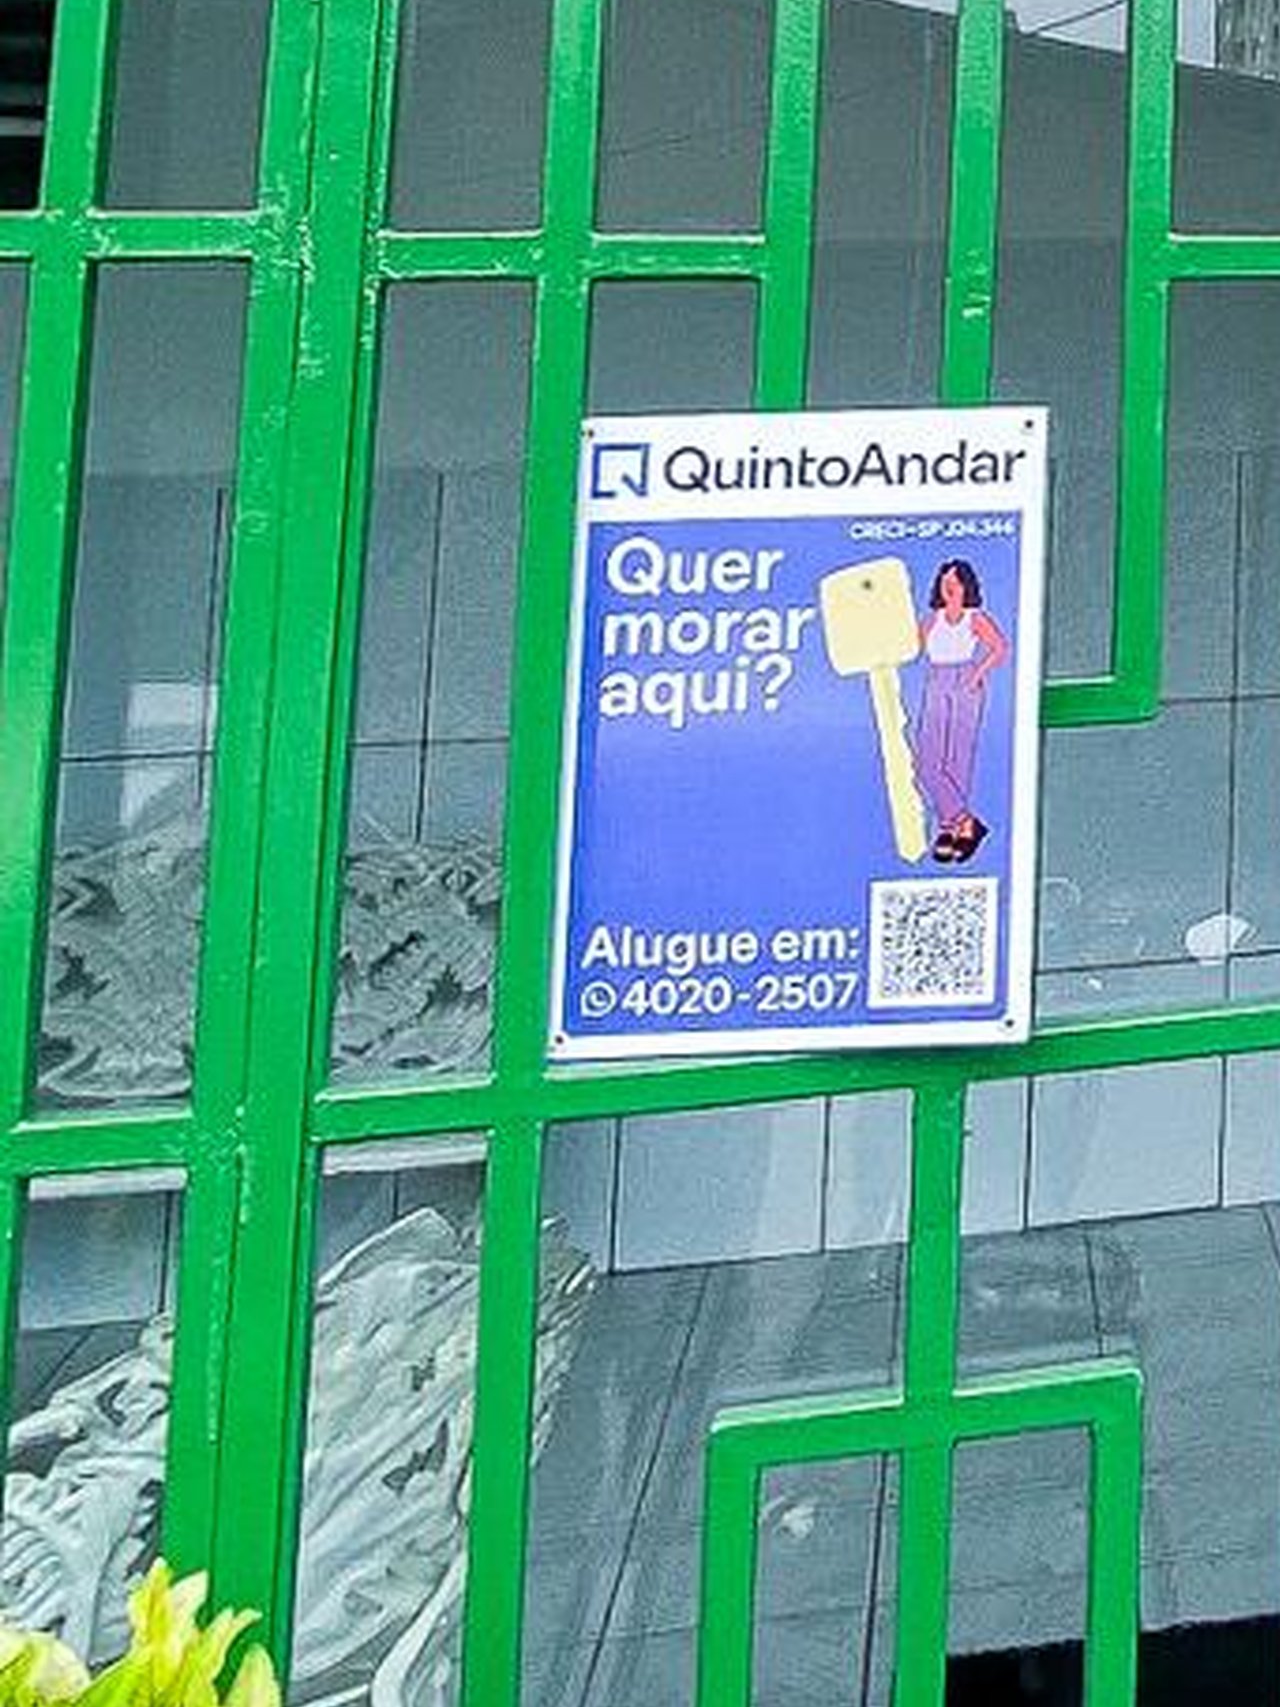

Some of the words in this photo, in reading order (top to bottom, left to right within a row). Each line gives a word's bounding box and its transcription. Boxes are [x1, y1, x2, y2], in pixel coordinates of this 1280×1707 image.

[664, 441, 1026, 492] QuintoAndar
[604, 538, 784, 595] Quer
[603, 606, 816, 658] morar
[599, 656, 794, 728] aqui?
[580, 925, 758, 974] Alugue
[771, 925, 861, 964] em:
[624, 974, 857, 1018] 4020-2507
